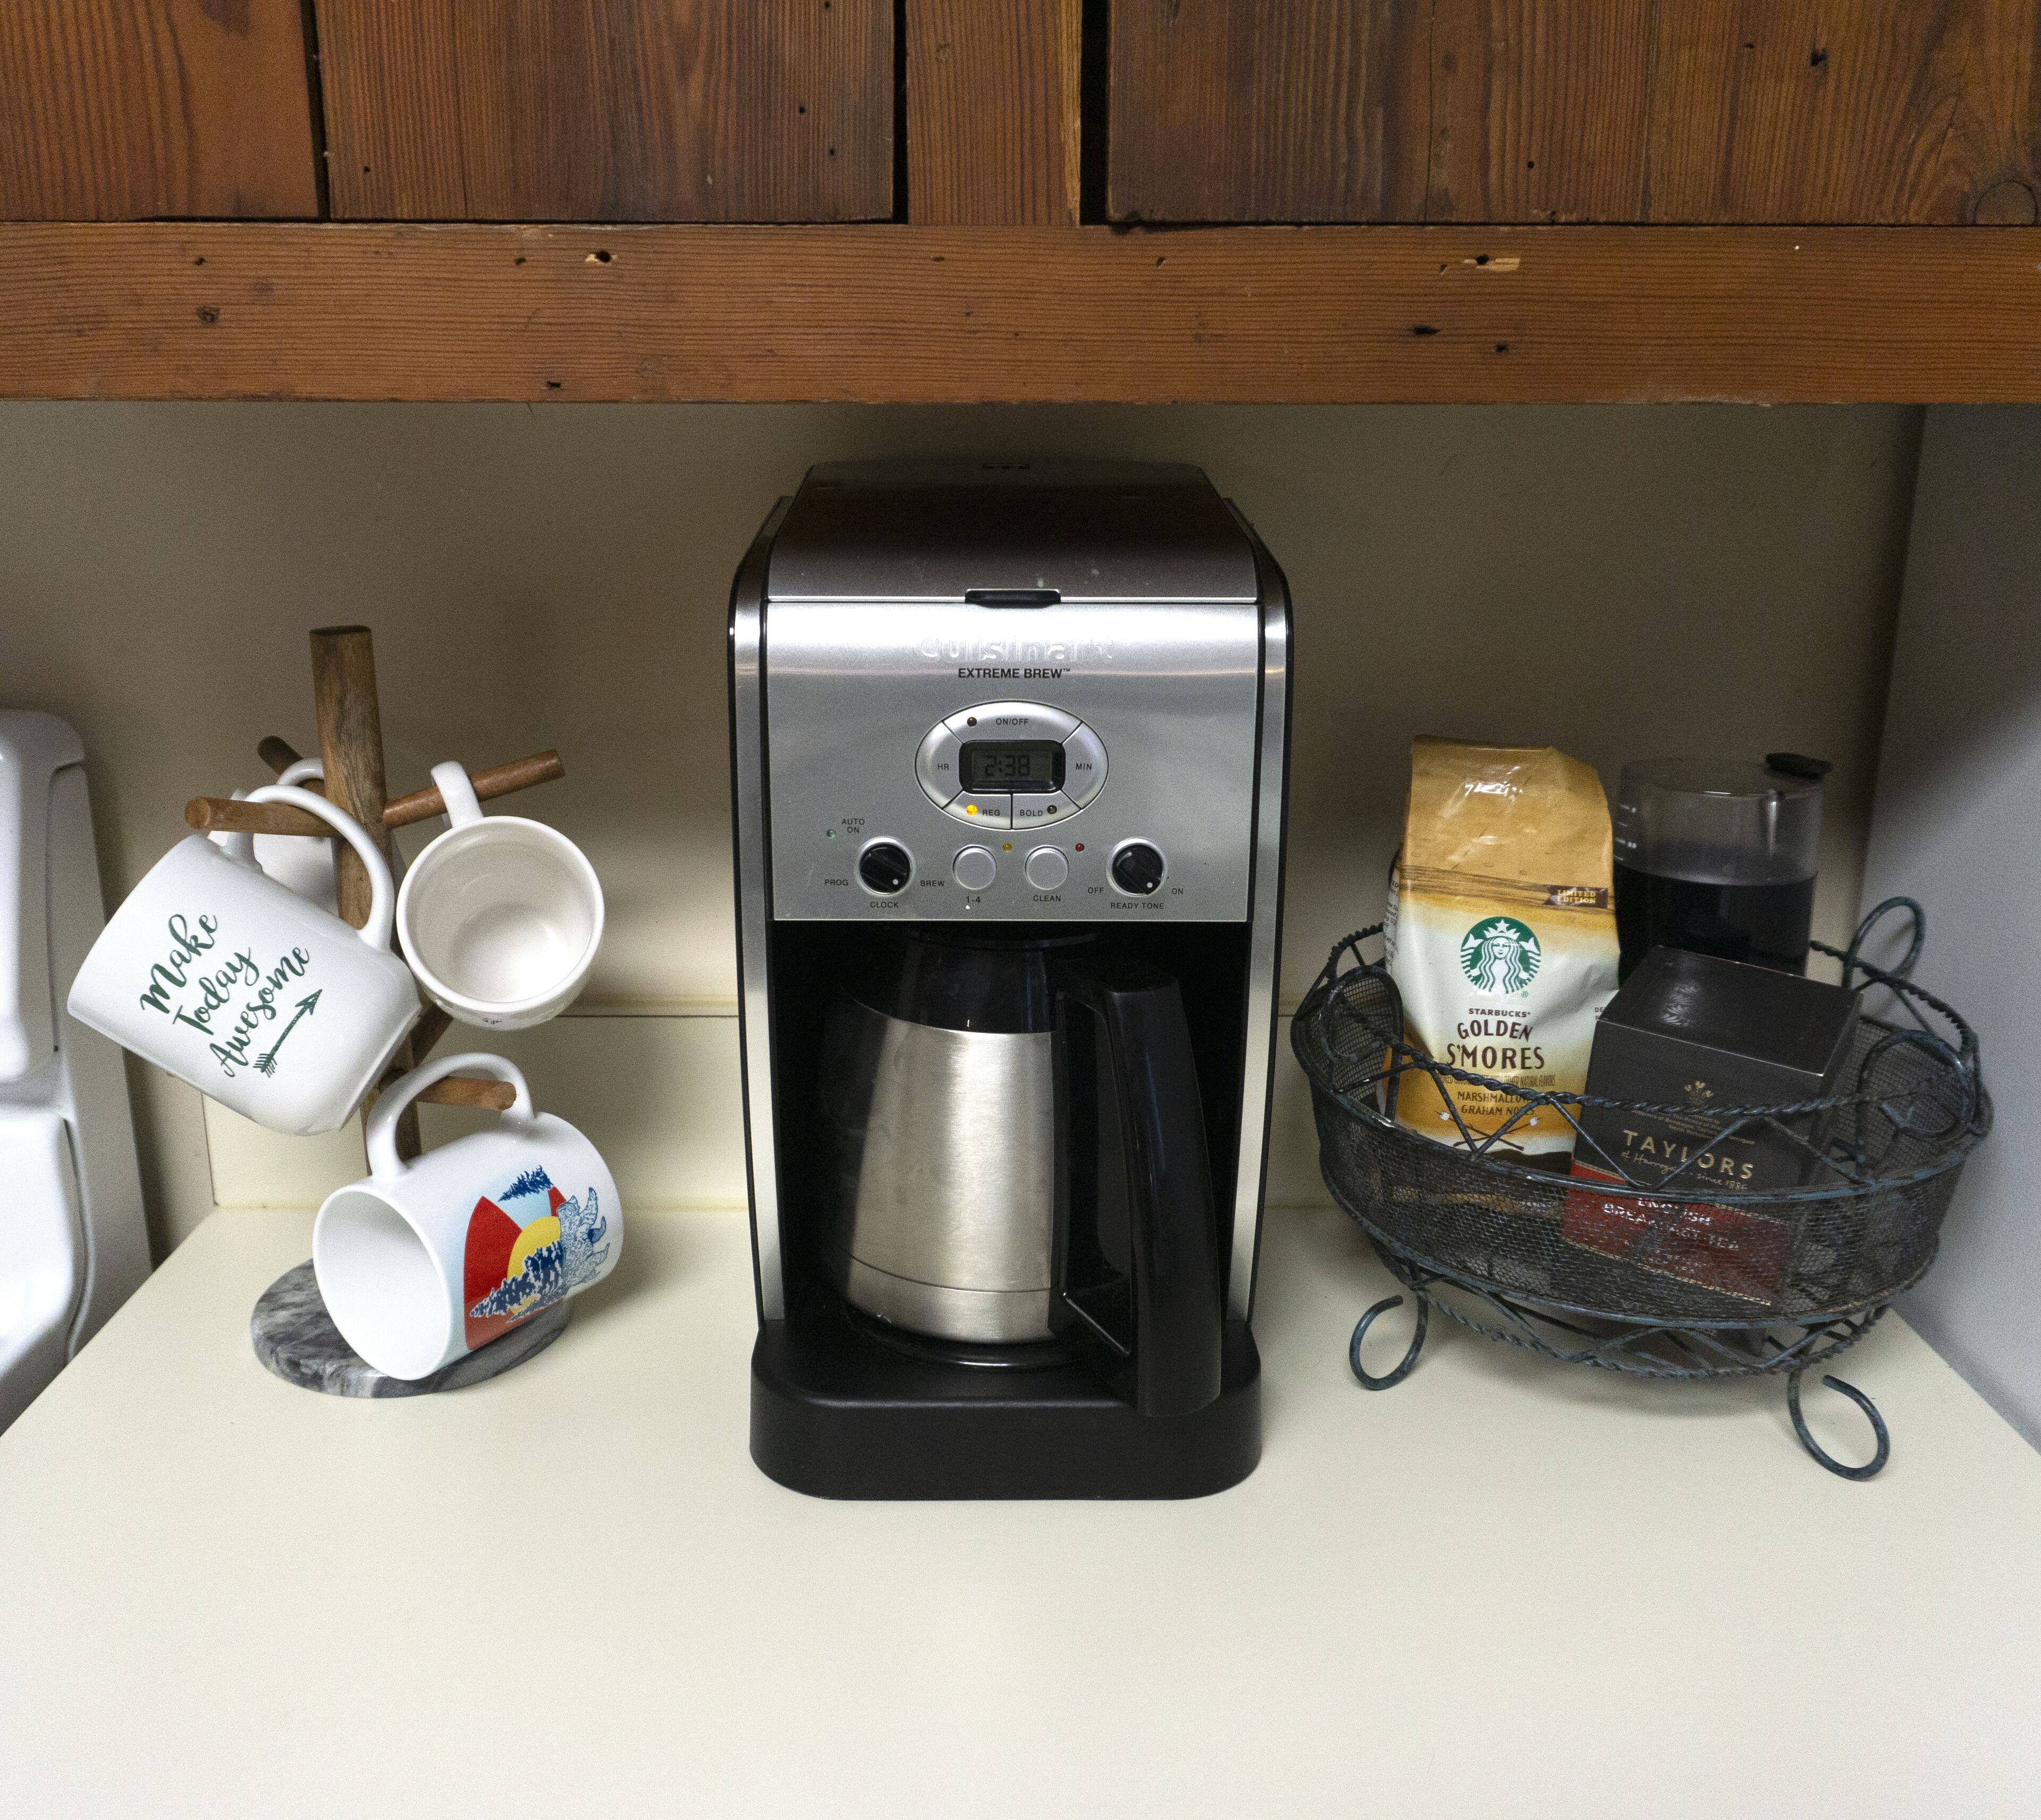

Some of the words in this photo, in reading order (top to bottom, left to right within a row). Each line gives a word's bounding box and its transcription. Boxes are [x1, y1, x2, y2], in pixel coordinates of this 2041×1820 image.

[913, 637, 1114, 661] Cuisinart
[958, 668, 1020, 679] EXTREME
[984, 755, 1031, 777] 2:38
[140, 913, 218, 1014] Make
[172, 947, 260, 1036] Today
[209, 947, 310, 1078] Awesome
[1457, 1019, 1533, 1042] GOLDEN
[1446, 1043, 1545, 1070] S'MORES
[1457, 1091, 1531, 1103] MARSHMALLO
[1461, 1104, 1503, 1115] GRAHAM
[1623, 1129, 1754, 1179] TAYLORS
